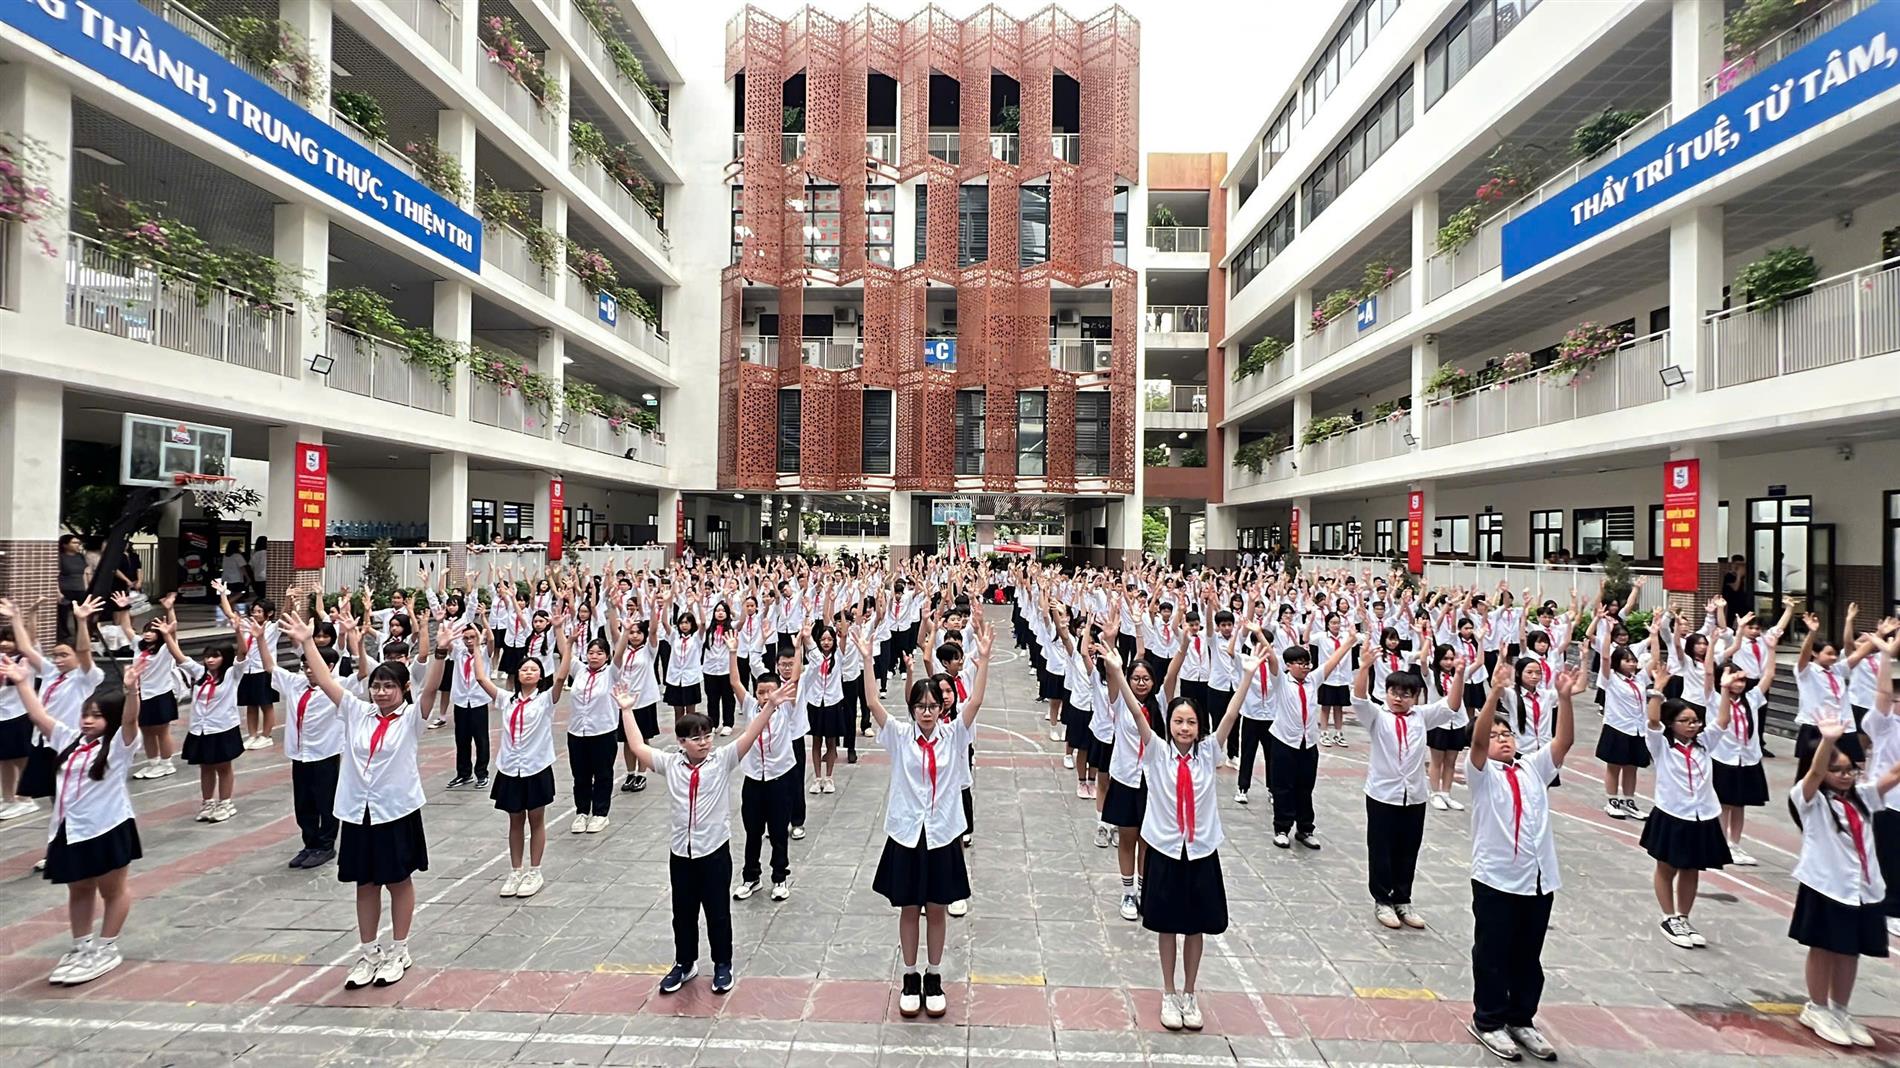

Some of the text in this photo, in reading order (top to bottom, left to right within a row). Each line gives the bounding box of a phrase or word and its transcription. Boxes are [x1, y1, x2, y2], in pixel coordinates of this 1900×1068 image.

[1632, 143, 1675, 193] TRÍ
[1676, 114, 1740, 170] TUỆ,
[1744, 78, 1795, 133] TỪ
[1798, 31, 1898, 104] TÂM,
[75, 0, 217, 114] THÀNH,
[223, 88, 319, 165] TRUNG
[322, 148, 388, 210] THỰC,
[392, 190, 445, 238] THIỆN
[447, 222, 473, 253] TRI
[607, 299, 615, 321] B
[1365, 301, 1373, 323] A
[936, 342, 948, 360] C
